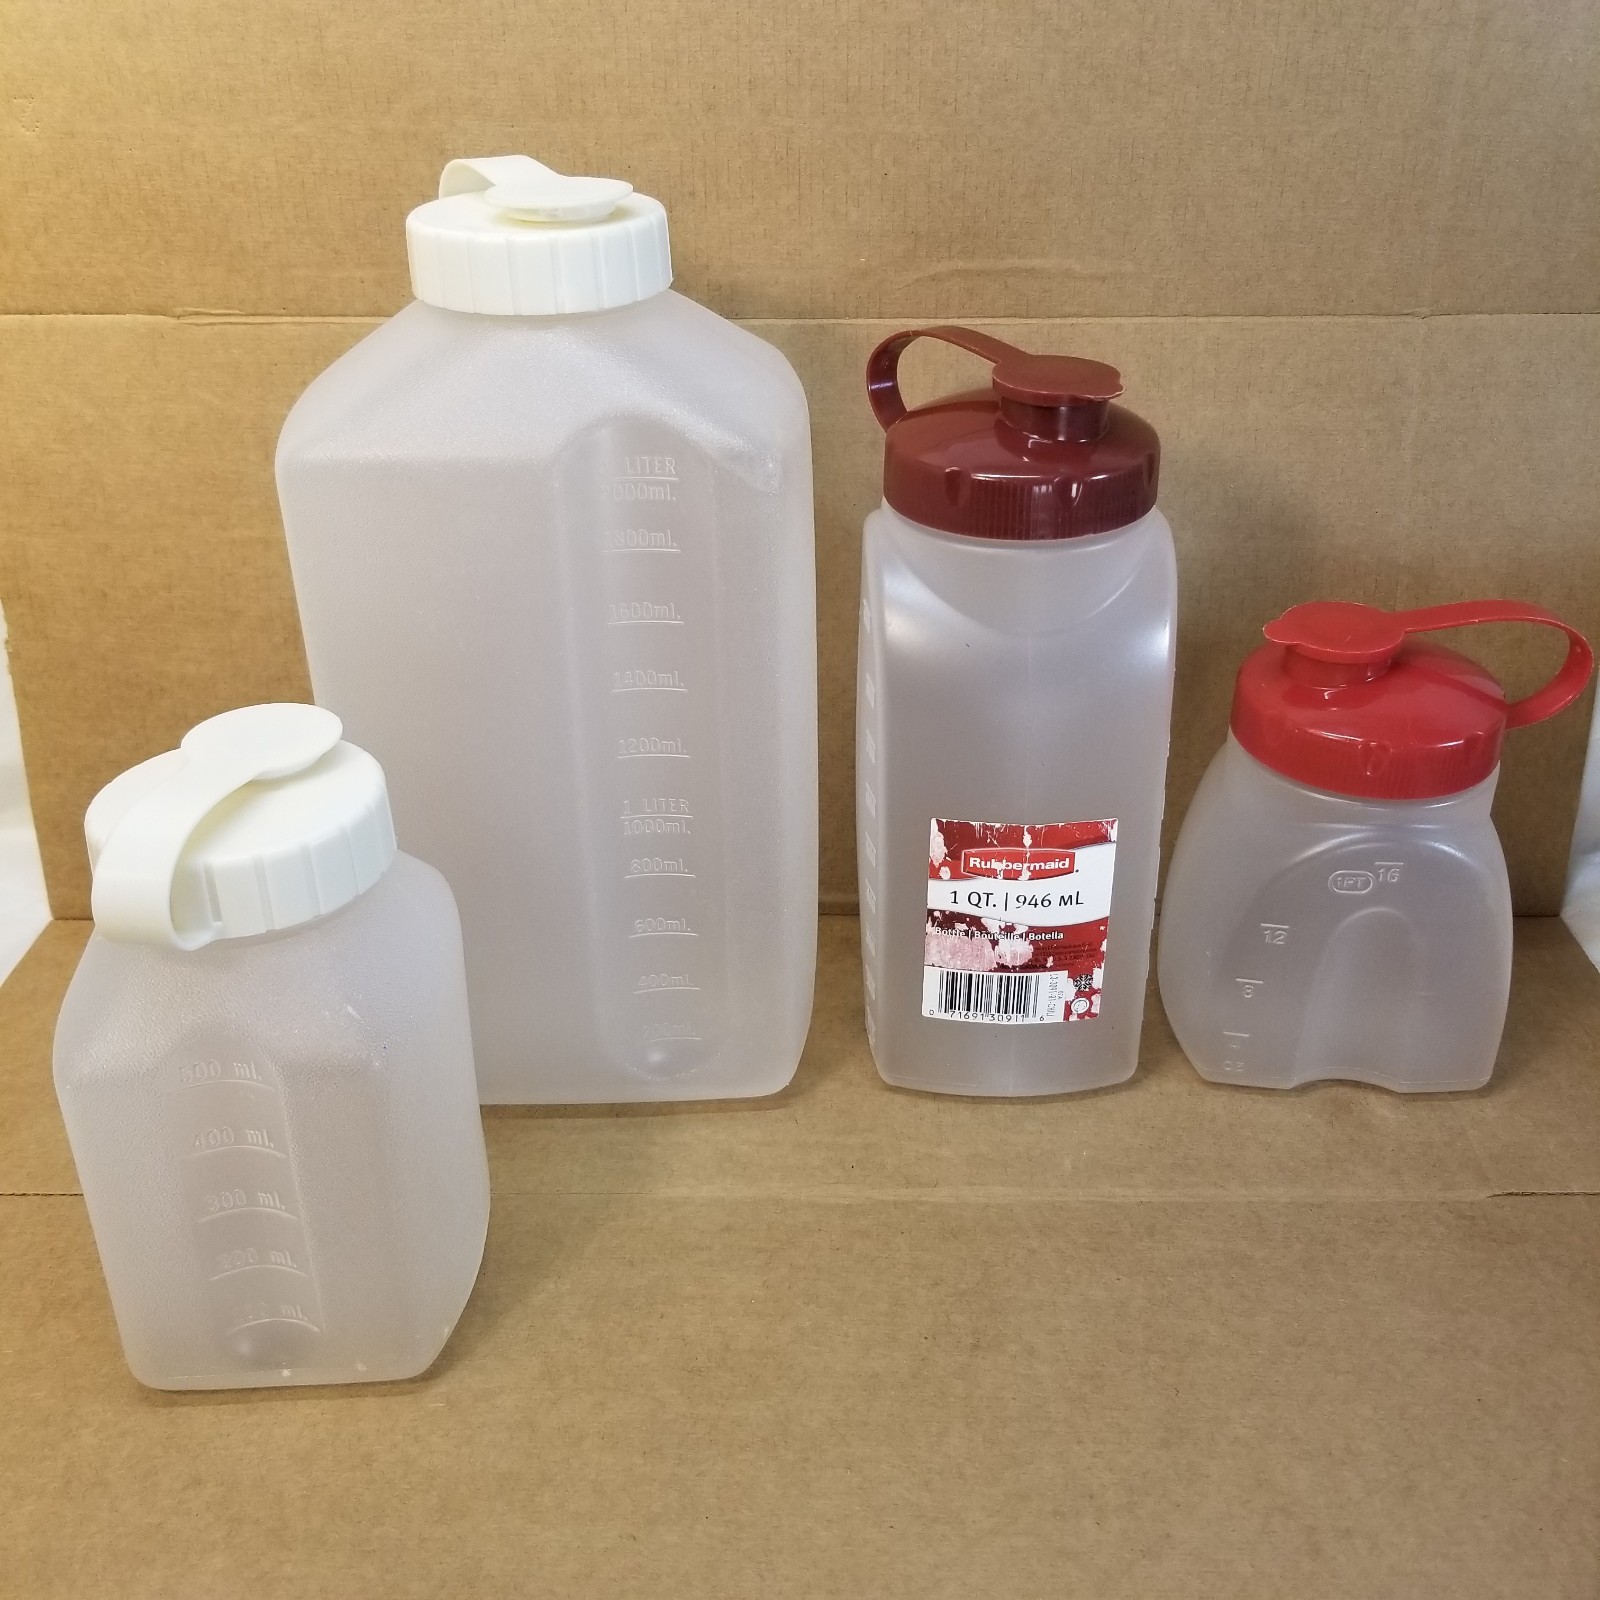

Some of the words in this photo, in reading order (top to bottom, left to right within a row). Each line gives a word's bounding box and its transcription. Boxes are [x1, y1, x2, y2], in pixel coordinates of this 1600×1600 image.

[624, 456, 676, 475] LITER
[645, 798, 689, 813] LITER
[969, 857, 1070, 872] Rubbermaid
[1377, 868, 1400, 883] 16
[950, 890, 959, 905] 1
[967, 891, 997, 909] QT.
[1015, 893, 1052, 909] 946
[1028, 930, 1064, 941] Botella
[1264, 930, 1288, 945] 12
